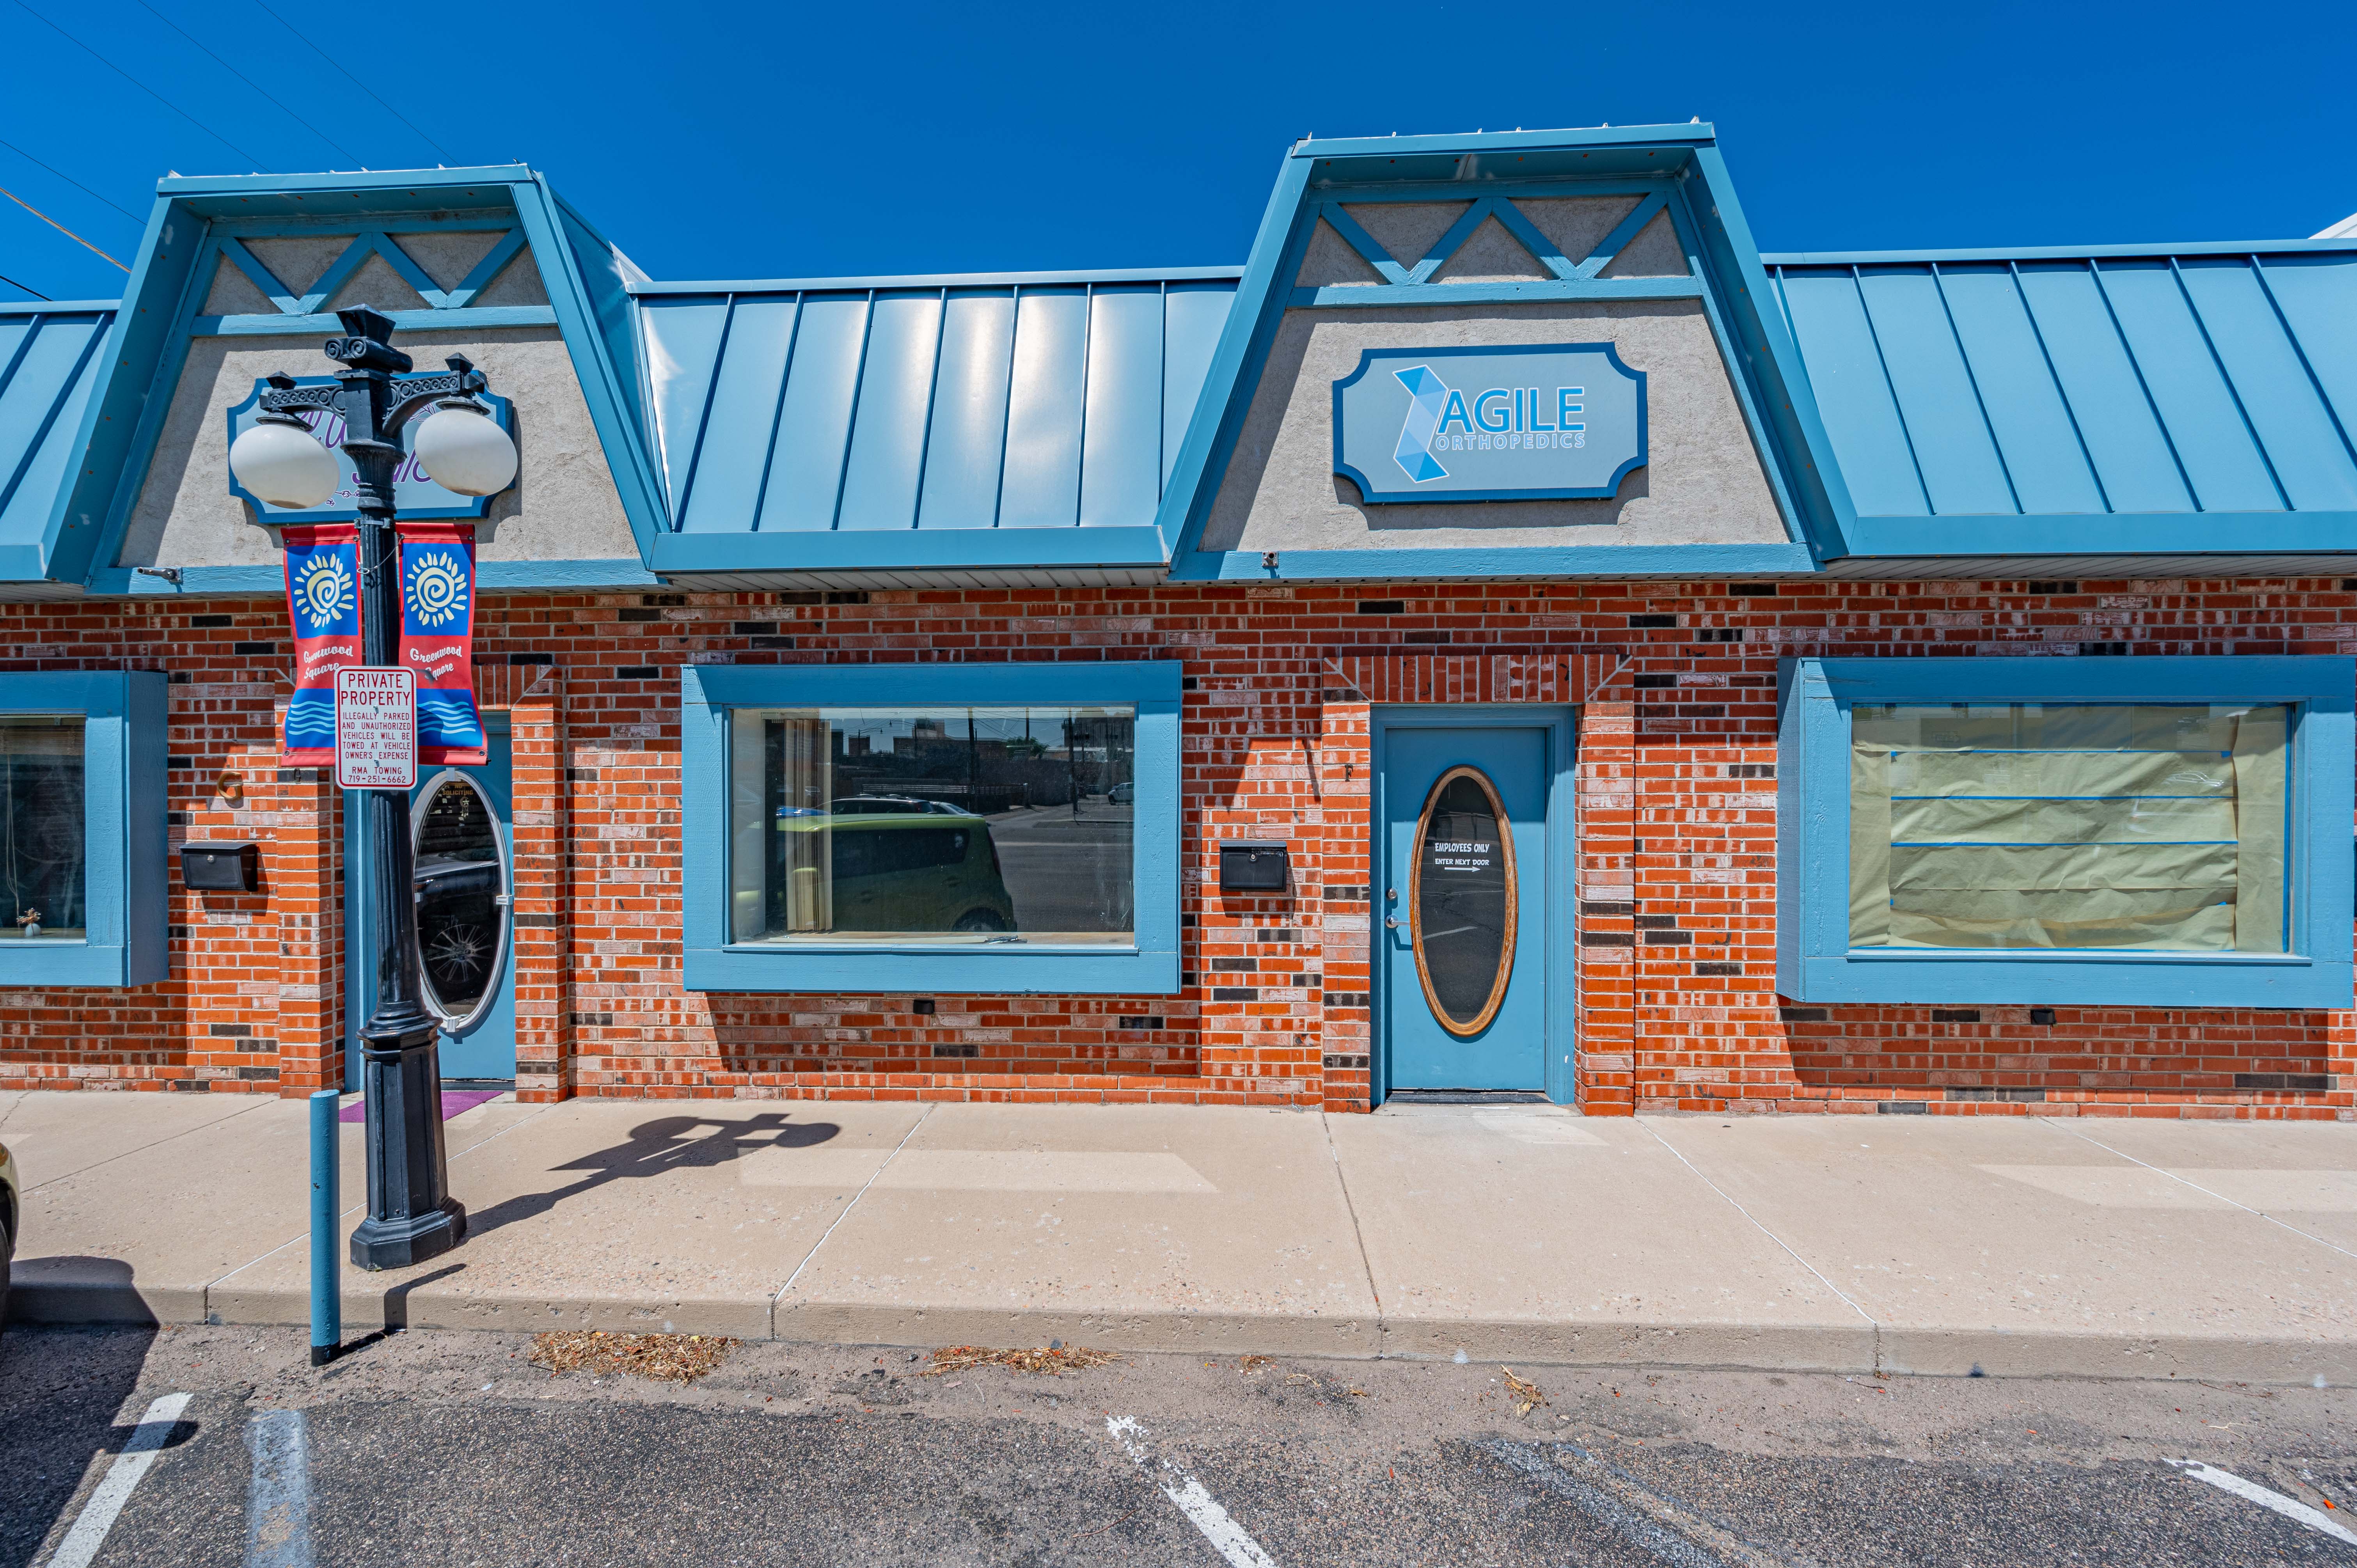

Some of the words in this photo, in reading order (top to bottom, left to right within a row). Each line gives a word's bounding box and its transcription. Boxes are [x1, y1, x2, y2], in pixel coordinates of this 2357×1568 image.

[1436, 387, 1585, 435] AGILE
[1436, 433, 1585, 451] ORTHOPEDICS
[410, 646, 462, 663] Greenwood
[304, 663, 339, 680] Square
[348, 673, 403, 688] PRIVATE
[341, 691, 410, 706] PROPERTY
[1344, 764, 1353, 782] F
[217, 771, 243, 801] G
[1435, 843, 1472, 853] EMPLOYEES
[1474, 843, 1490, 853] ONLY
